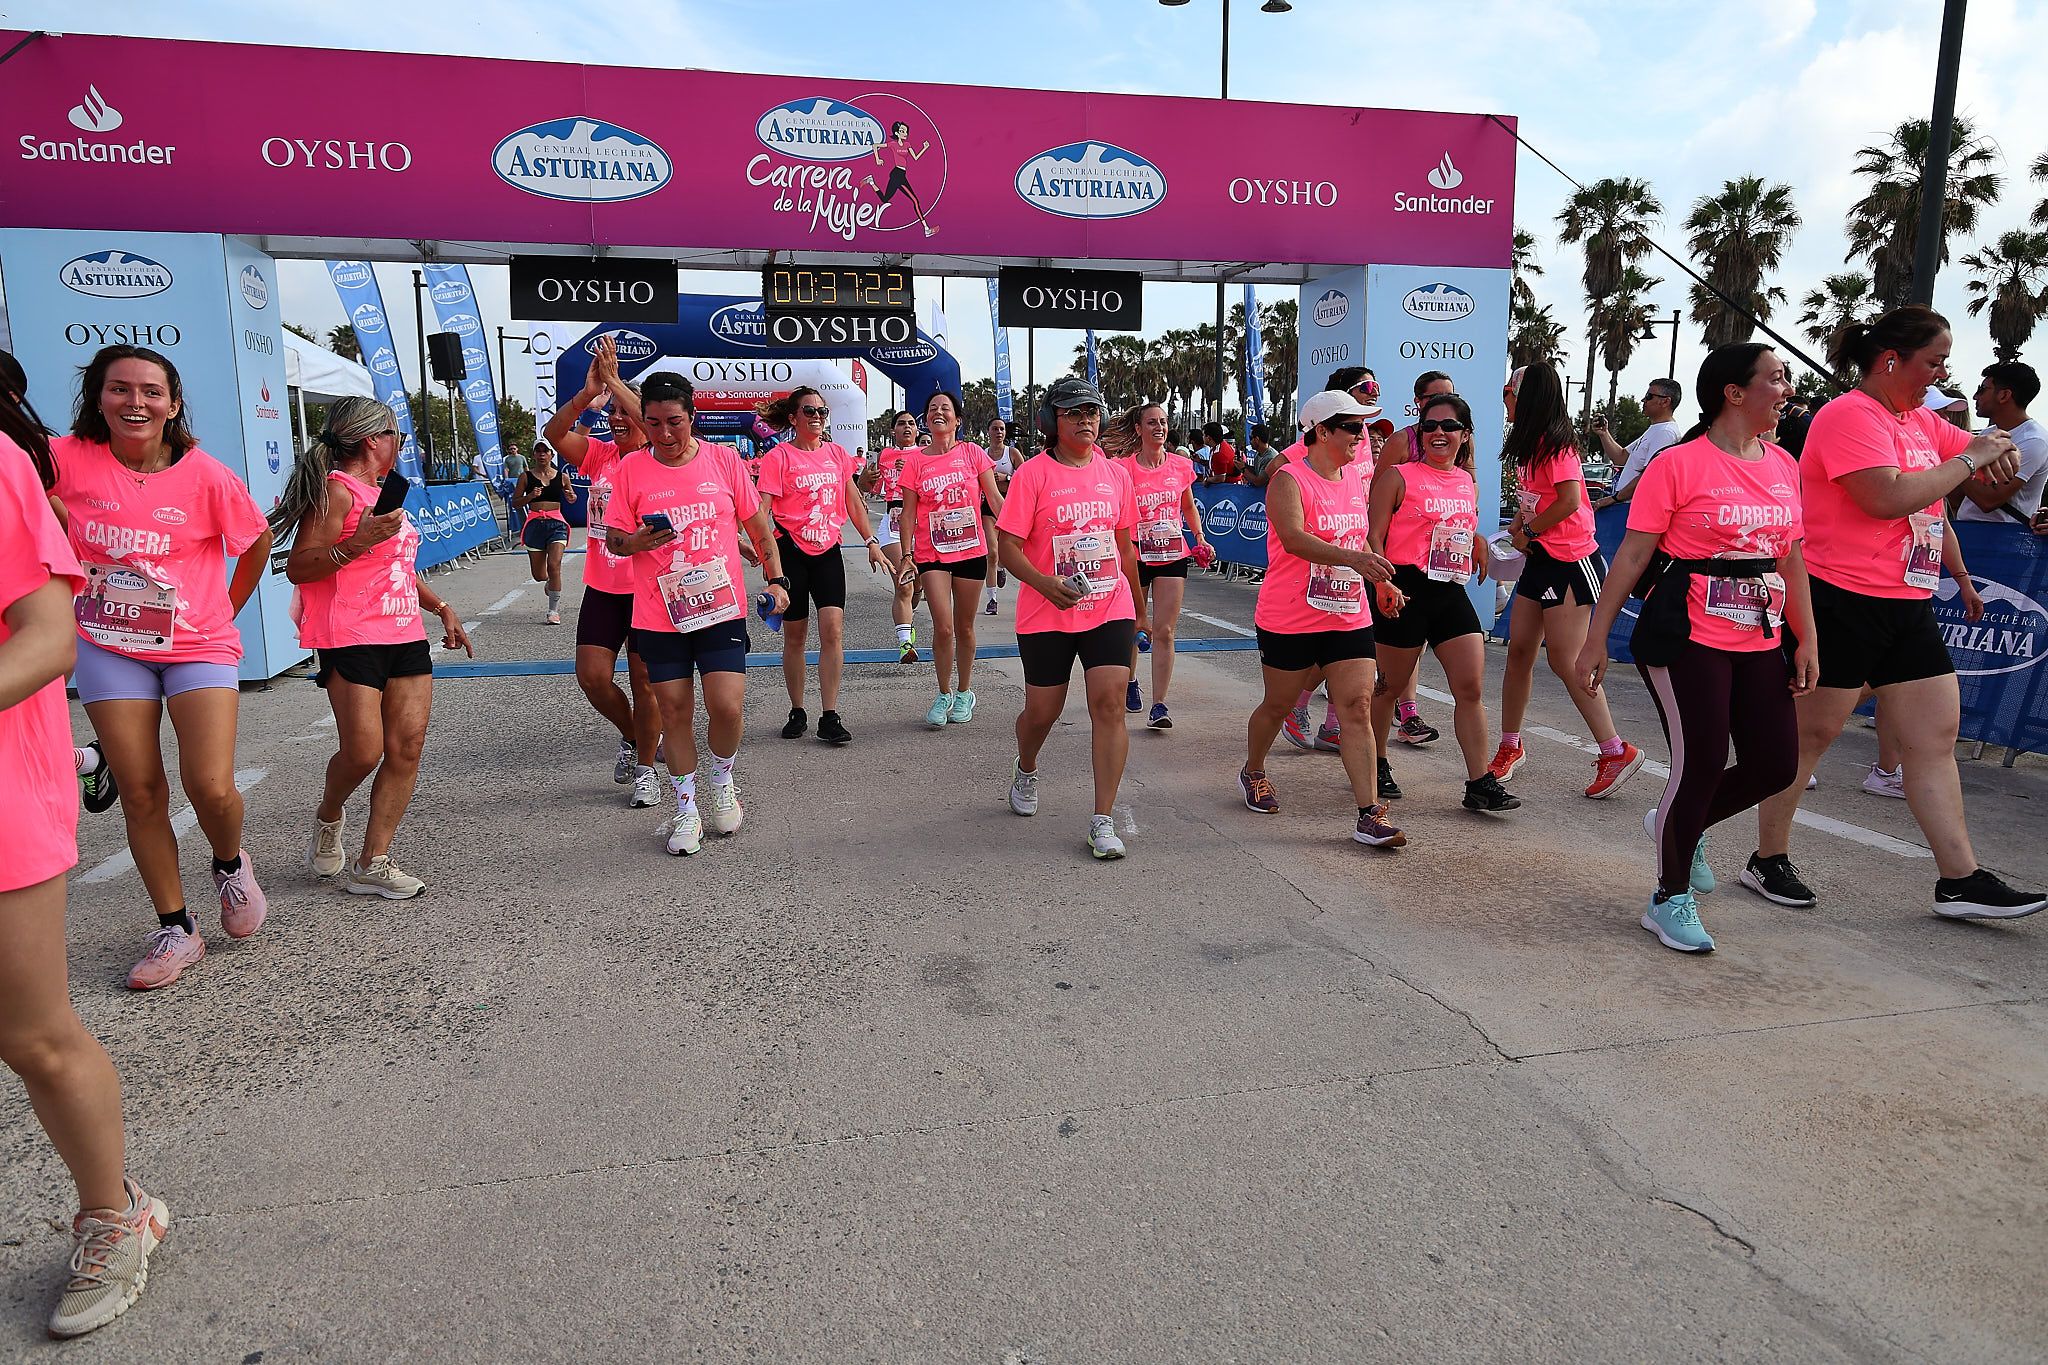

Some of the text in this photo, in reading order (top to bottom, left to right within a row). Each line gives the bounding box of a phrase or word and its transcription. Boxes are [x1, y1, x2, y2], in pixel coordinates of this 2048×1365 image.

[786, 117, 872, 128] CENTRAL LECHERA
[766, 118, 875, 146] ASTURIANA
[19, 134, 176, 165] Santander
[261, 136, 413, 172] OYSHO
[534, 144, 652, 158] CENTRAL LECHERA
[507, 145, 660, 182] ASTURIANA
[746, 153, 853, 190] Carrera
[1050, 167, 1151, 177] CENTRAL LECHERA
[1027, 168, 1156, 200] ASTURIANA
[1228, 178, 1338, 207] OYSHO
[1393, 191, 1495, 214] Santander
[773, 187, 891, 241] de la Mujer
[69, 266, 167, 287] ASTURIANA
[537, 278, 655, 305] OYSHO
[774, 271, 903, 305] 00:37:22
[1022, 286, 1123, 314] OYSHO
[1407, 296, 1469, 313] ASTURIANA
[1316, 304, 1346, 321] ASTURIANA
[65, 323, 182, 347] OYSHO
[772, 316, 911, 344] OYSHO
[244, 329, 274, 356] OYSHO
[1399, 341, 1475, 360] OYSHO
[876, 347, 934, 360] ASTURIANA
[1311, 343, 1349, 366] OYSHO
[692, 361, 793, 383] OYSHO
[727, 390, 773, 399] Santander
[819, 383, 850, 391] OYSHO
[836, 423, 864, 431] OYSHO
[795, 472, 839, 489] CARRERA
[922, 471, 965, 493] CARRERA
[647, 489, 675, 502] OYSHO
[1050, 487, 1077, 498] OYSHO
[1136, 490, 1178, 507] CARRERA
[1711, 486, 1745, 496] OYSHO
[1056, 500, 1114, 523] CARRERA
[1425, 498, 1474, 514] CARRERA
[1717, 504, 1793, 526] CARRERA
[1317, 513, 1368, 531] CARRERA
[85, 520, 172, 556] CARRERA
[946, 528, 964, 537] 016
[1153, 538, 1170, 547] 016
[1077, 560, 1102, 572] 016
[109, 576, 146, 588] ASTURIANA
[1330, 580, 1351, 591] 016
[1738, 583, 1768, 598] 016
[688, 591, 715, 607] 016
[1076, 602, 1094, 612] 2026
[1312, 600, 1334, 608] OYSHO
[103, 601, 141, 619] 016
[1751, 865, 1766, 884] HOKA
